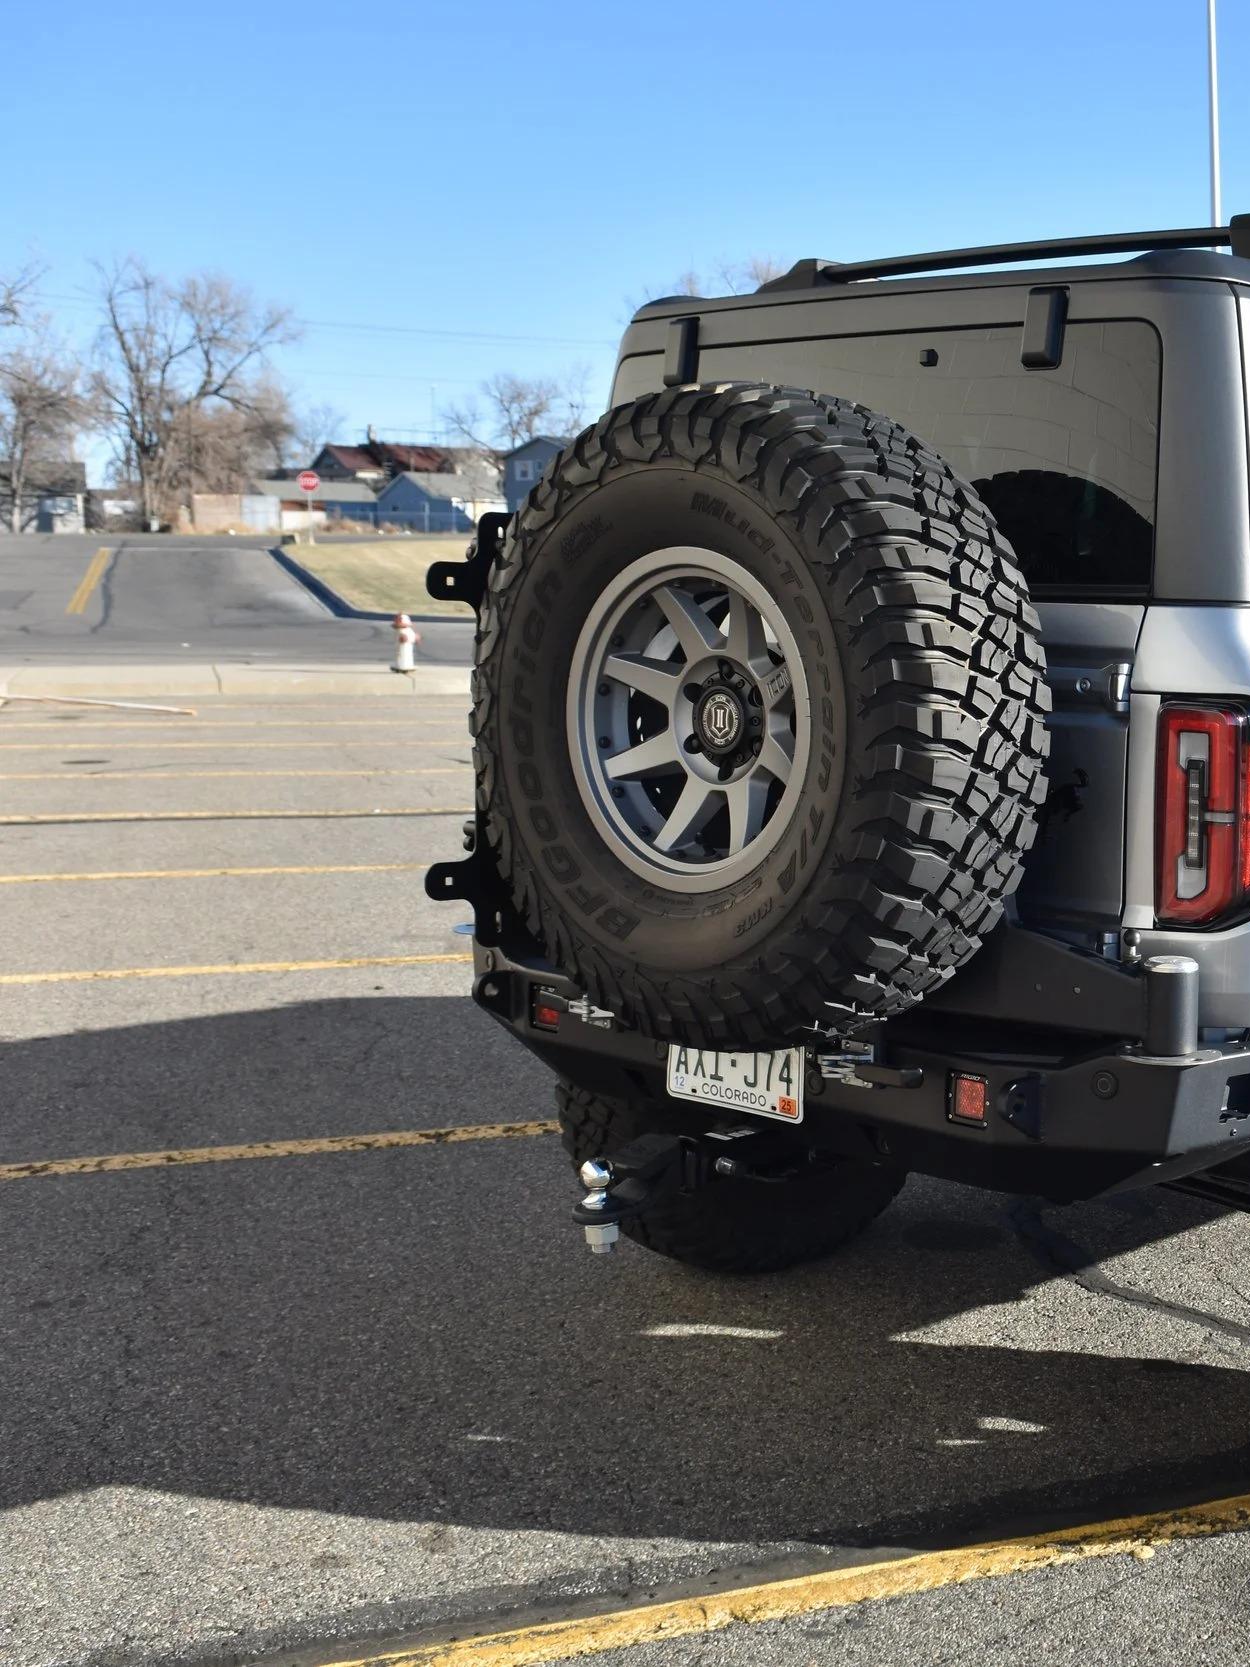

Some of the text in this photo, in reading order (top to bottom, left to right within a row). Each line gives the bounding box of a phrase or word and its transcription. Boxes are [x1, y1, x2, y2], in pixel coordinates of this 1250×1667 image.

[766, 666, 791, 700] ICON
[508, 568, 641, 941] BFGoodrich
[777, 804, 825, 895] T/A
[674, 1076, 685, 1087] 12
[701, 1082, 767, 1107] COLORADO
[781, 1099, 792, 1112] 25
